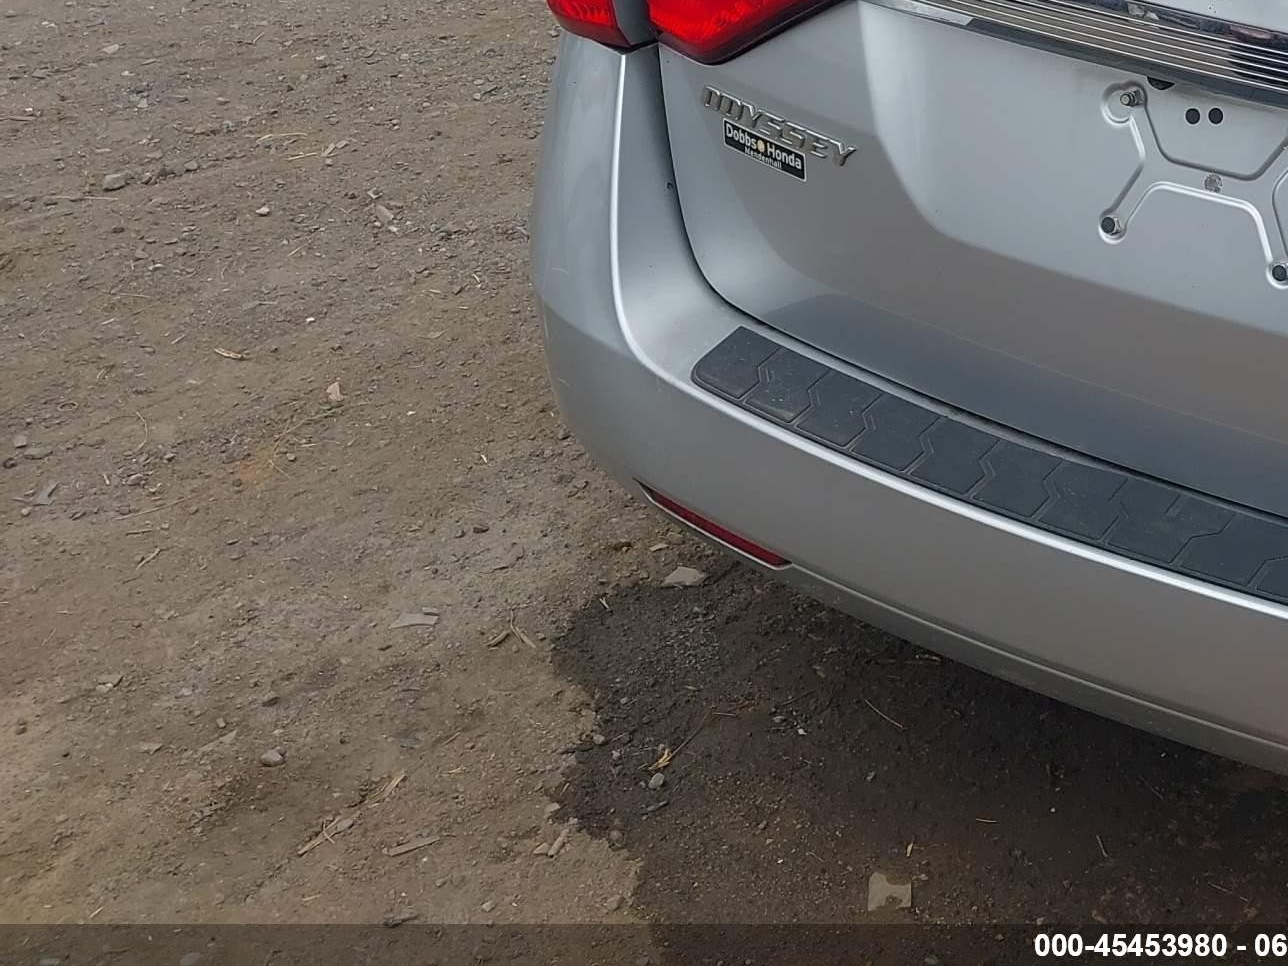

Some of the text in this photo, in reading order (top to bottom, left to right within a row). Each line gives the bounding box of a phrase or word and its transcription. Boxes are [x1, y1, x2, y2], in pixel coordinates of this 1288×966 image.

[725, 122, 802, 169] Dobbs Honda
[744, 146, 782, 169] Mendenhall
